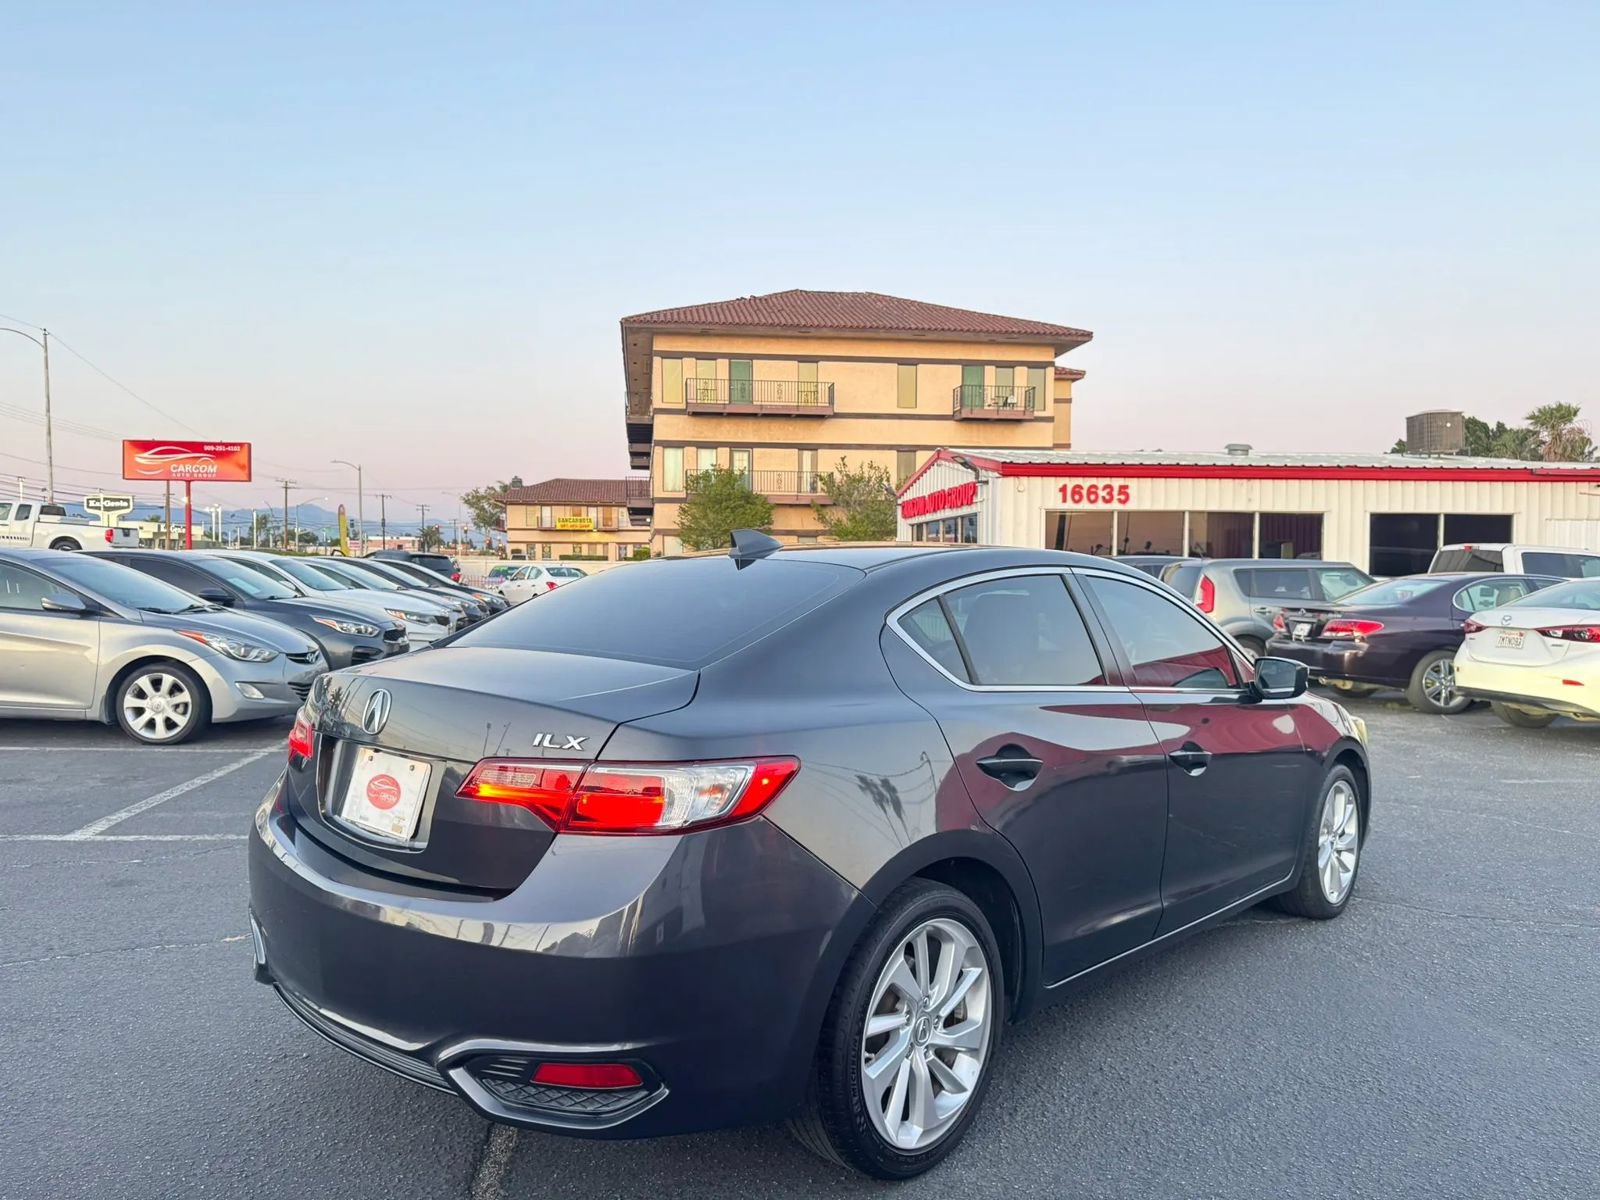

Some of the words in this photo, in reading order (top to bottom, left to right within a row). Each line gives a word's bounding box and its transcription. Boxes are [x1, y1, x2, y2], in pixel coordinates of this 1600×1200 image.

[170, 464, 217, 473] CARCOM
[925, 489, 946, 513] AUTO
[945, 481, 977, 508] GROUP
[1058, 483, 1131, 505] 16635
[532, 733, 590, 751] ILX
